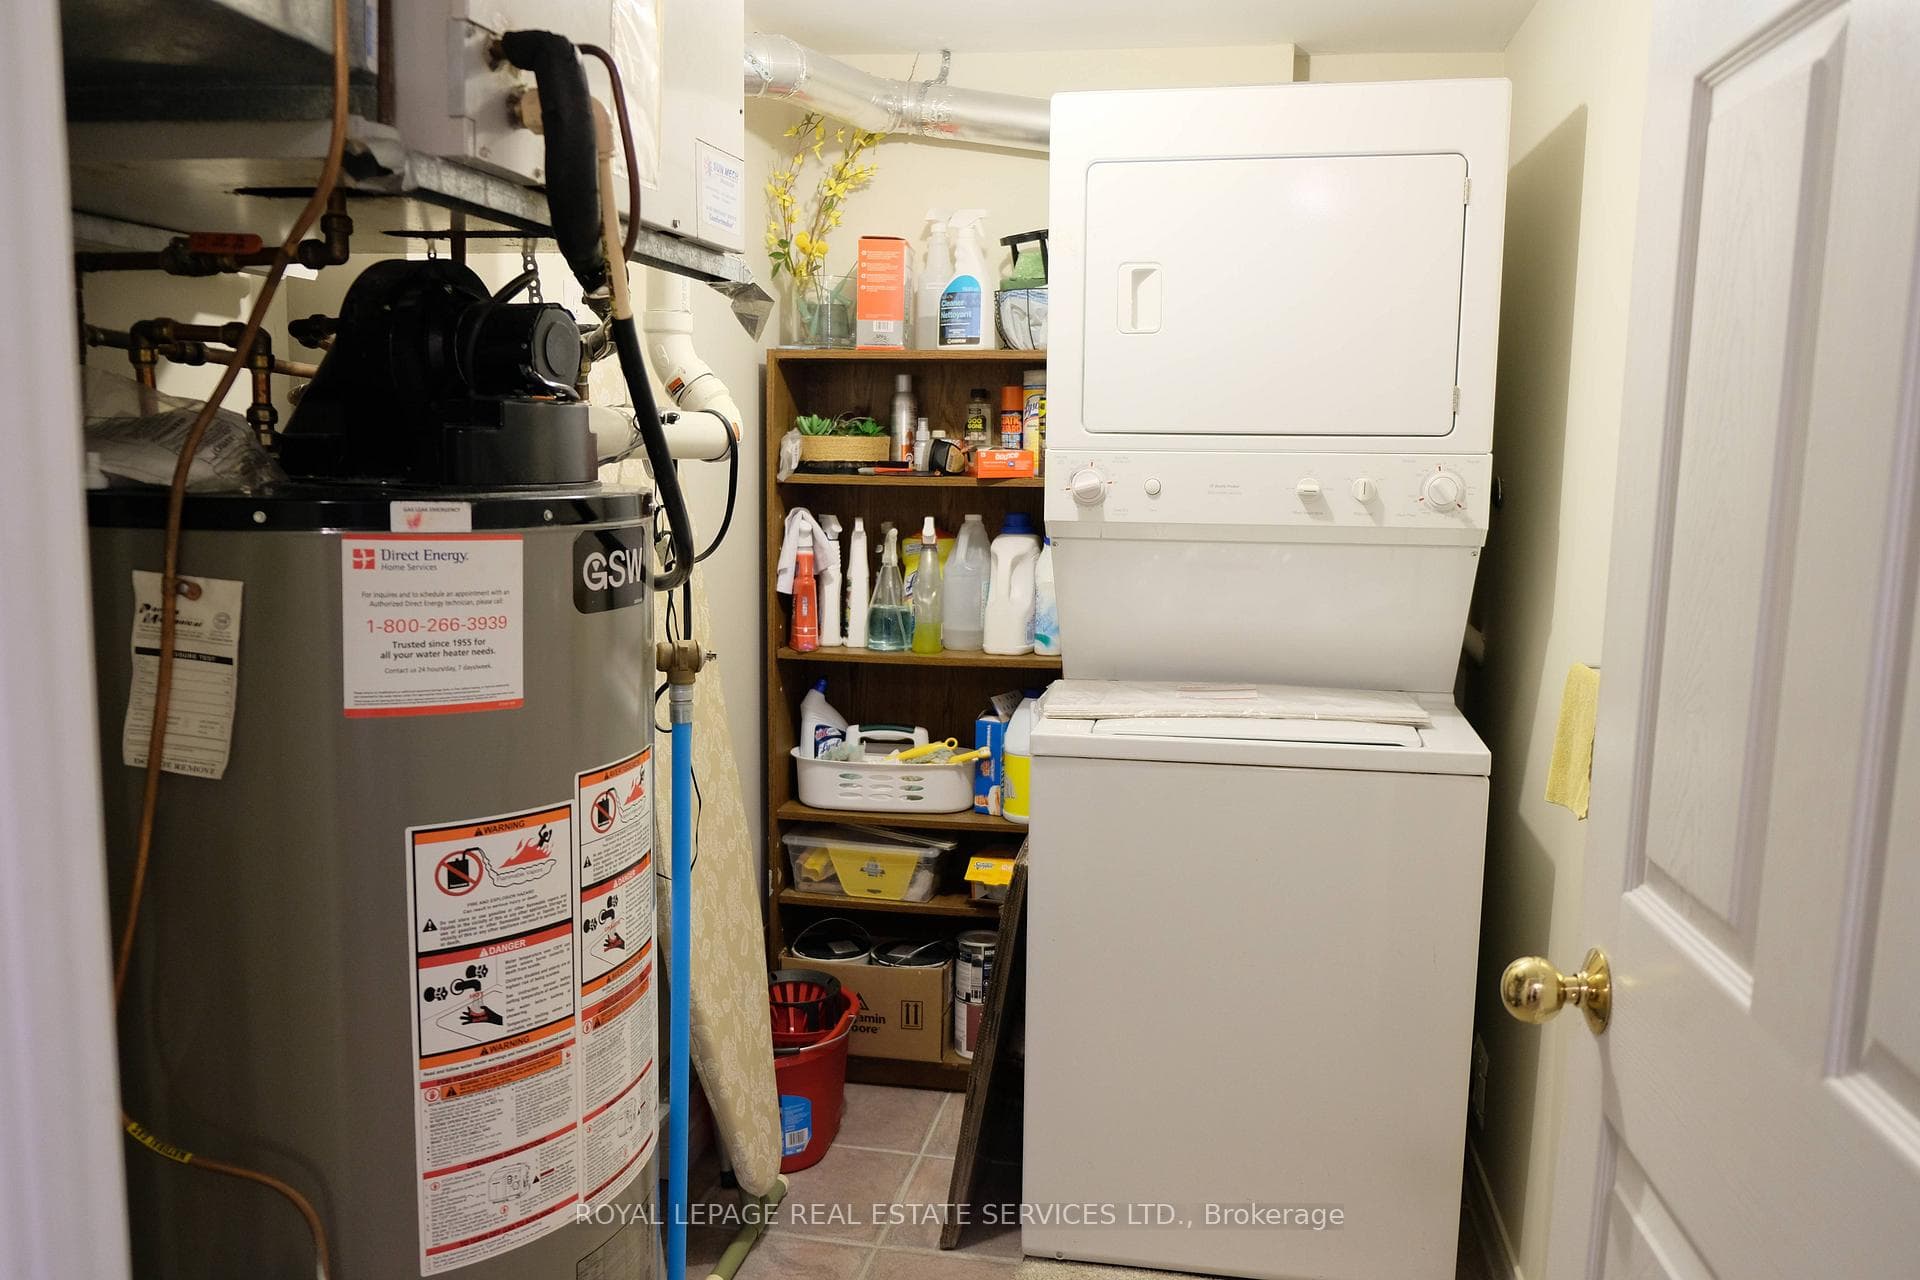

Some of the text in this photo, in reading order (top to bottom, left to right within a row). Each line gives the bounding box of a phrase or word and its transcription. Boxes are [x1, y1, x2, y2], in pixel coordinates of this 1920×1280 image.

[381, 549, 420, 561] Direct
[381, 563, 437, 571] Home Services
[583, 547, 643, 591] GSW
[398, 590, 411, 598] and
[419, 589, 443, 597] schedule
[455, 589, 490, 598] appointment
[369, 600, 403, 608] Authorized
[424, 600, 444, 609] Energy
[366, 615, 508, 634] 1-800-266-3939
[392, 638, 486, 650] Trusted since 1955 for
[380, 647, 496, 661] all your water heater needs.
[384, 667, 408, 675] Contact
[483, 819, 525, 834] WARNING
[488, 939, 526, 956] DANGER
[851, 1025, 879, 1034] oore
[489, 1036, 530, 1055] WARNING
